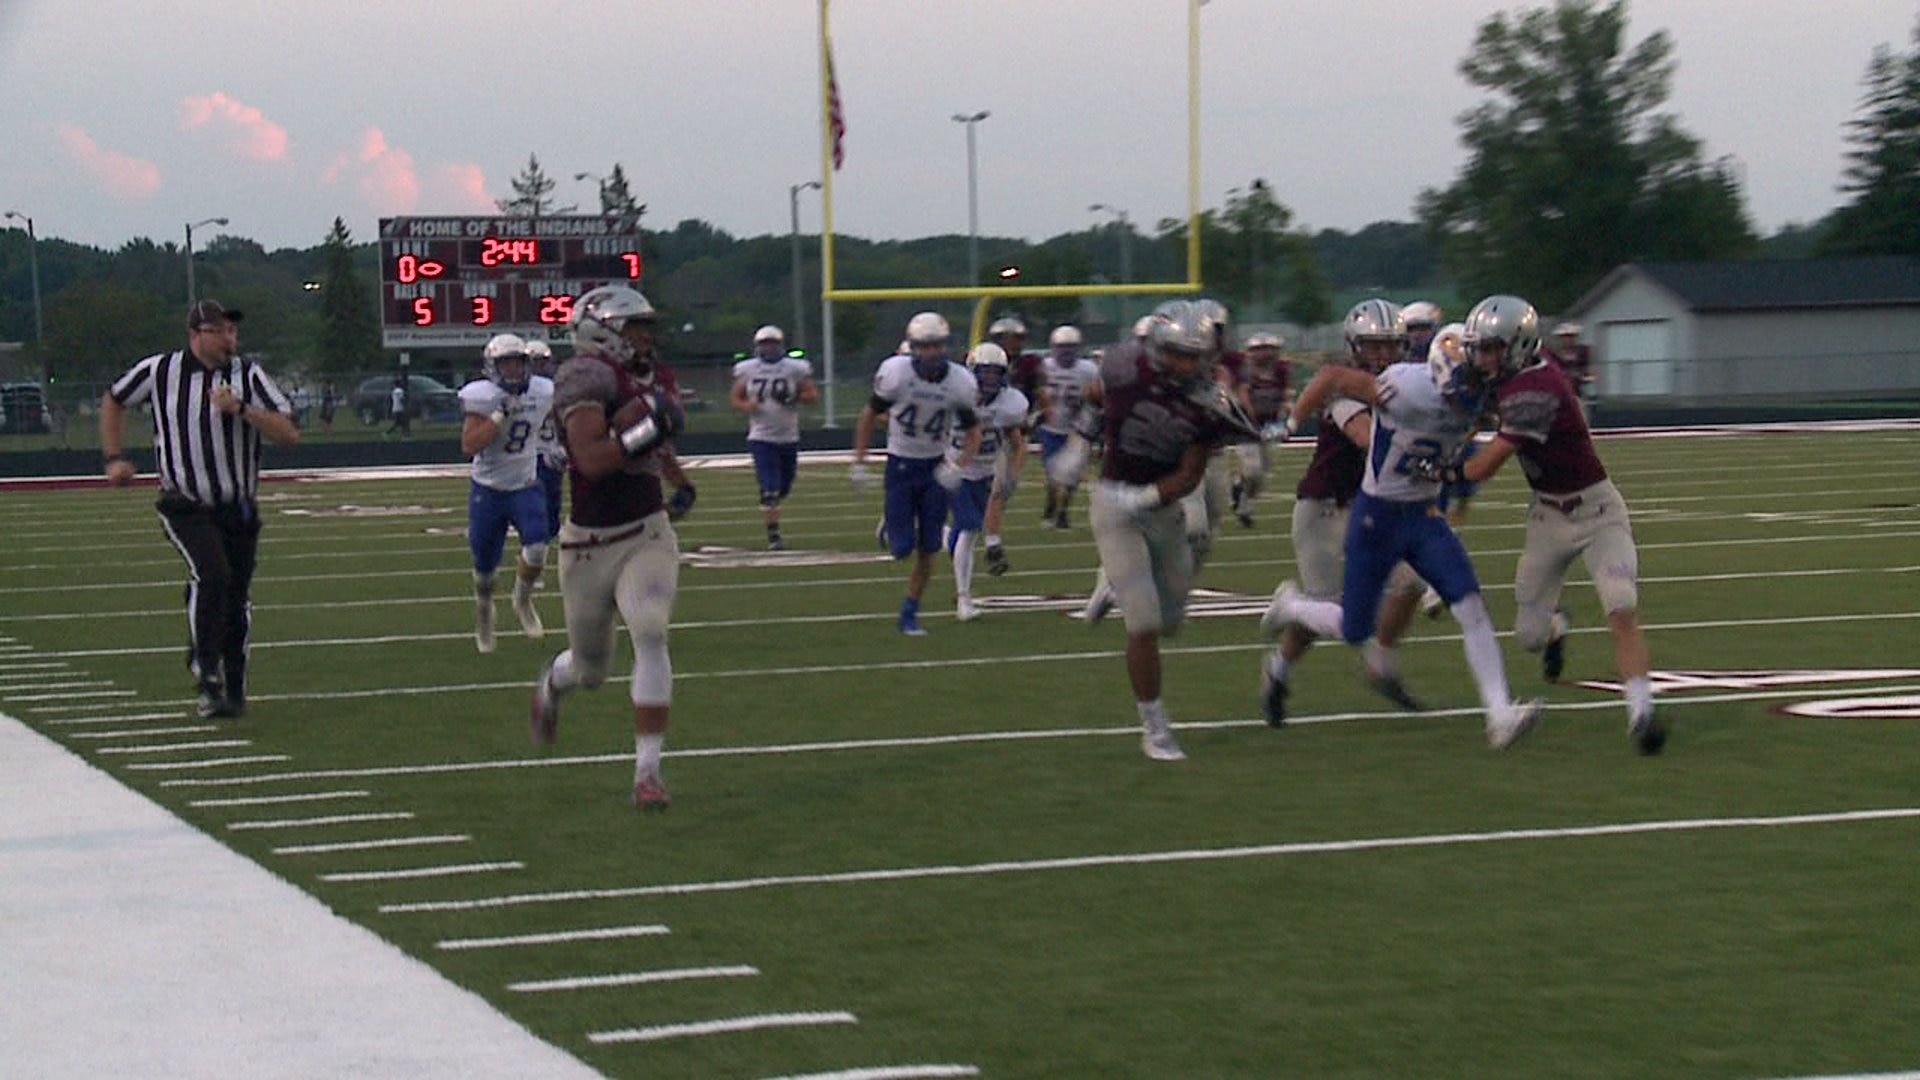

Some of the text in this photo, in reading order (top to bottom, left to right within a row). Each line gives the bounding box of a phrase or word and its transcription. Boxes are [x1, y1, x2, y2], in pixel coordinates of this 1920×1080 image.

[409, 219, 608, 236] HOME OF THE INDIANS
[481, 238, 536, 266] 2:44
[620, 253, 638, 278] 7
[414, 297, 432, 325] 5
[473, 297, 490, 324] 3
[540, 296, 573, 323] 25
[896, 403, 947, 442] 44
[504, 420, 531, 453] 8
